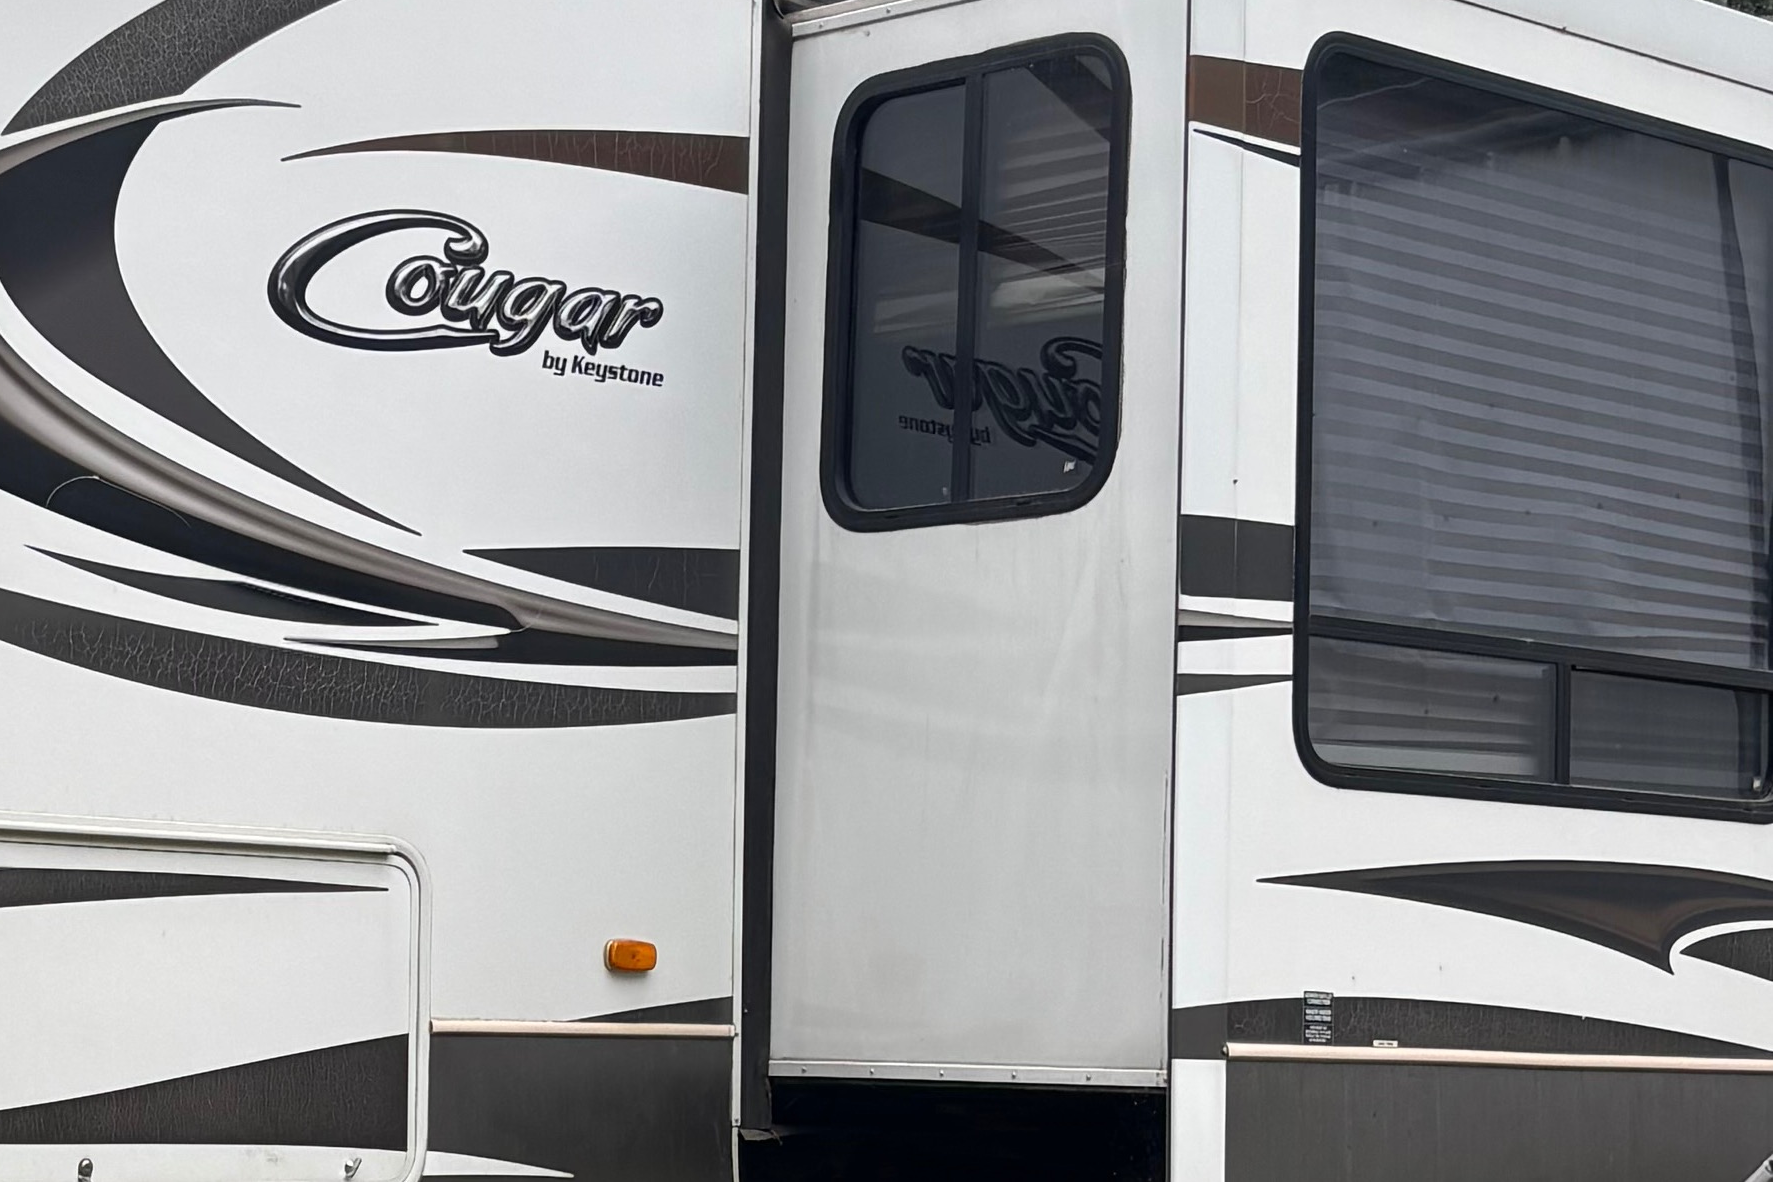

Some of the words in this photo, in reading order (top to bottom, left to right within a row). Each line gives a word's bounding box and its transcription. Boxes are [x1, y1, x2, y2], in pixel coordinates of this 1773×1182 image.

[267, 208, 663, 356] Cougar
[542, 350, 567, 378] by
[571, 354, 664, 387] Keystone
